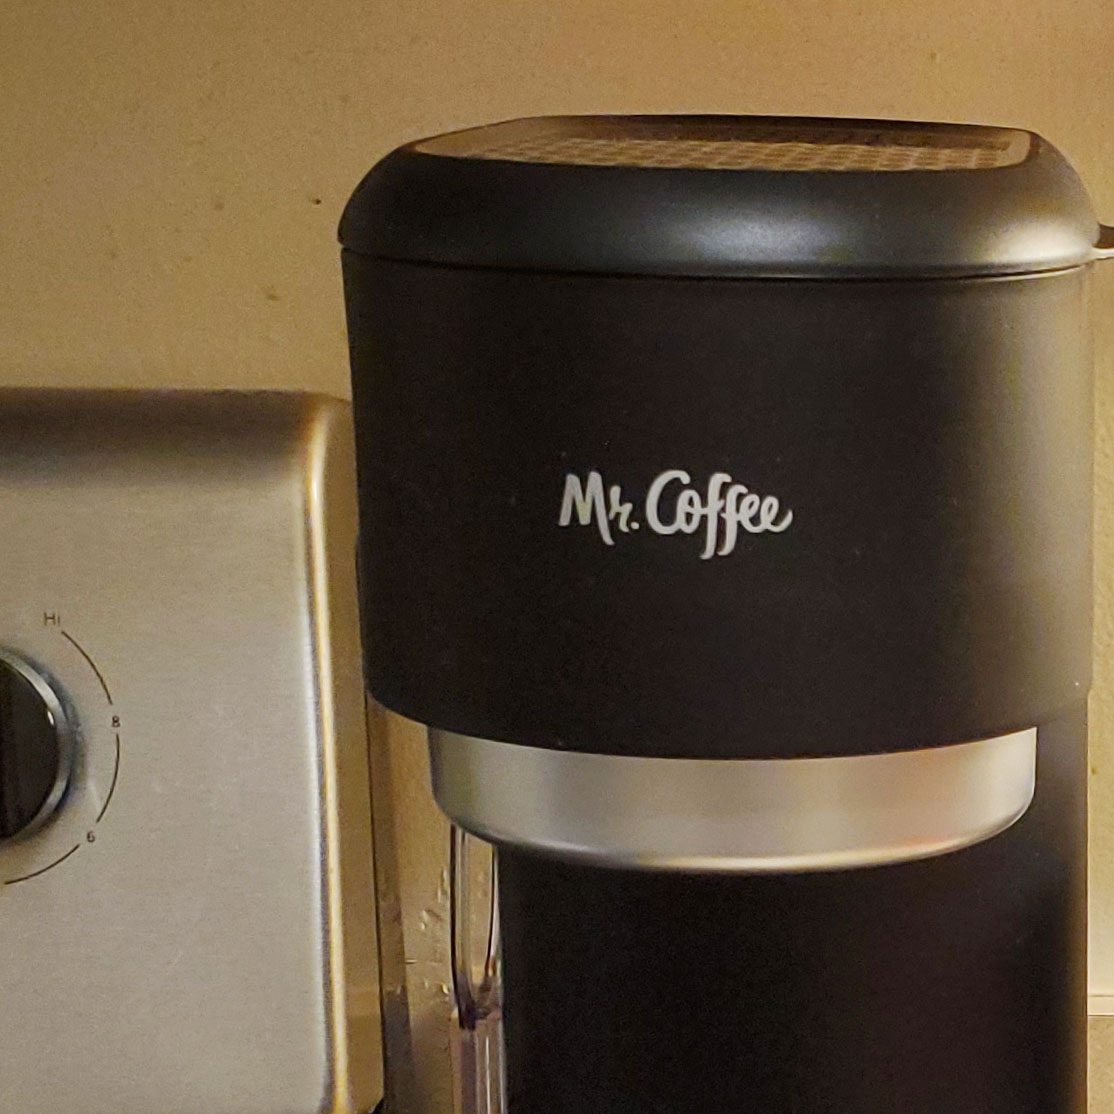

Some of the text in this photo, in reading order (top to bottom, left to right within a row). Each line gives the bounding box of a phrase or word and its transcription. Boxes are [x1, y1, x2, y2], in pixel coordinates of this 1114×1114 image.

[558, 469, 793, 560] Mr. Coffee
[111, 715, 121, 728] 8
